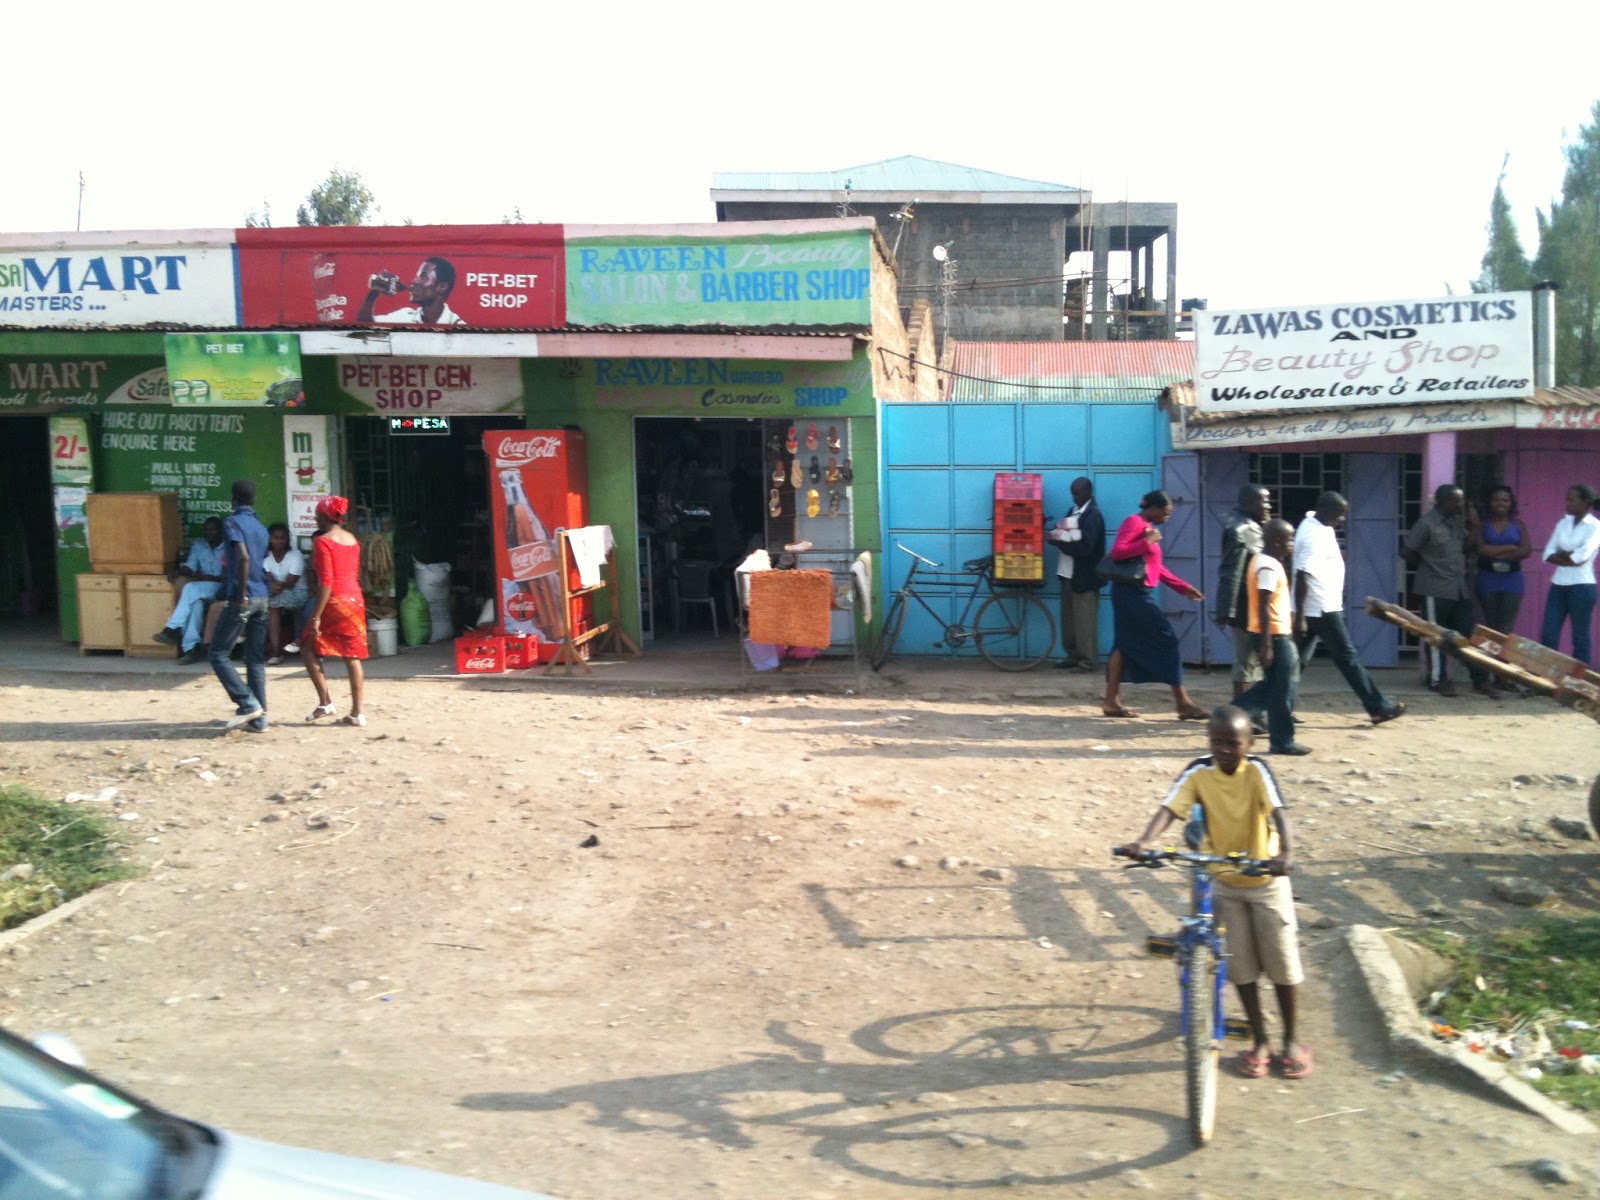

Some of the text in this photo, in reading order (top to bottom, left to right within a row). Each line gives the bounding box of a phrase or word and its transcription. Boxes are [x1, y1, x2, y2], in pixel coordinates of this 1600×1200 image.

[580, 246, 727, 272] RAVEEN
[466, 273, 538, 287] PET-BET
[702, 272, 799, 302] BARBER
[806, 268, 870, 300] SHOP
[480, 294, 528, 308] SHOP
[1213, 300, 1516, 339] ZAWAS COSMETICS
[1330, 328, 1417, 342] AND
[206, 344, 244, 353] PET BET
[1200, 341, 1500, 379] Beauty Shop
[9, 361, 107, 389] MART
[342, 365, 477, 388] PET-BET GEN.
[794, 387, 848, 406] SHOP
[1211, 382, 1383, 401] Wholesalers
[1416, 376, 1529, 392] Retailers
[376, 389, 443, 408] SHOP
[102, 412, 244, 433] HIRE OUT PARTY TENTS
[1303, 419, 1328, 433] all
[1329, 416, 1396, 434] Beauty
[56, 435, 87, 459] 2/-
[102, 433, 196, 451] ENQUIRE HERE
[151, 463, 216, 475] WALL UNITS
[150, 475, 221, 487] DINING TABLES
[178, 488, 208, 499] SETS
